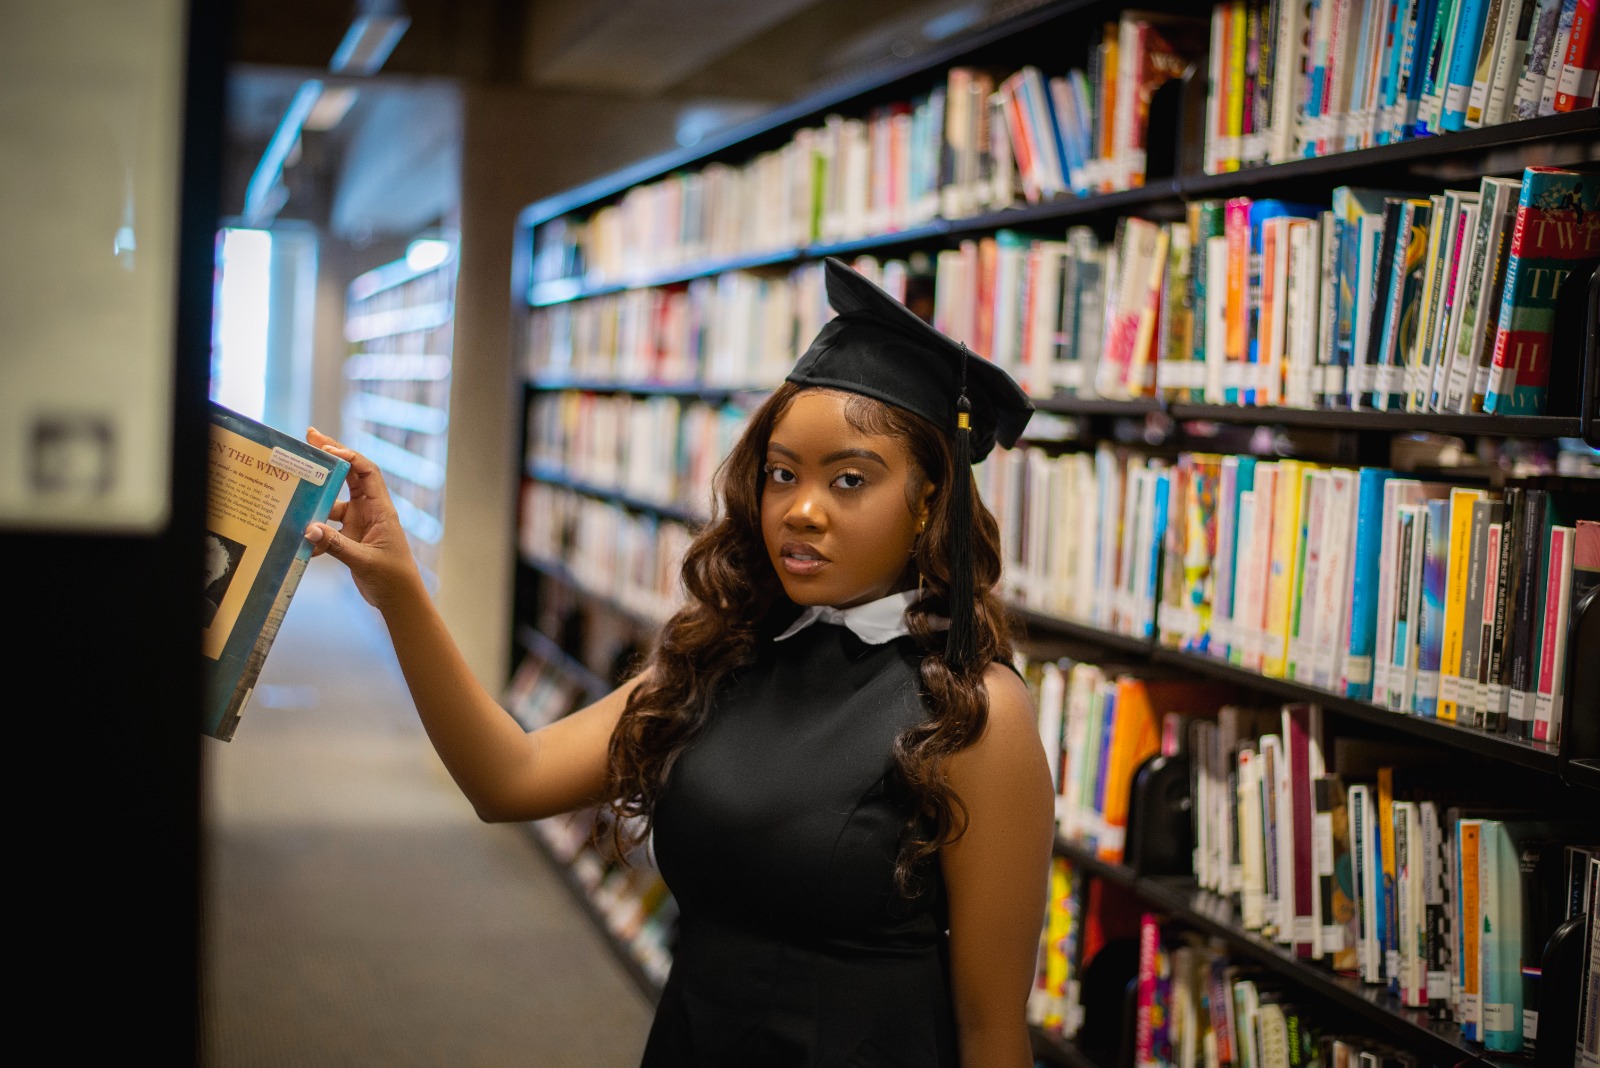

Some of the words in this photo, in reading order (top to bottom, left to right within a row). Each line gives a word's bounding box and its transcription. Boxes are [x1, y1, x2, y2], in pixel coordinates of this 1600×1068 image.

[1553, 32, 1563, 59] DANIEL
[1512, 197, 1527, 251] TWELVE
[1504, 254, 1519, 300] TRIBES
[226, 448, 254, 467] THE
[255, 460, 290, 483] WIND
[244, 475, 263, 486] complete
[1499, 533, 1510, 584] SOMERSET
[1495, 587, 1506, 640] MAUGHAM
